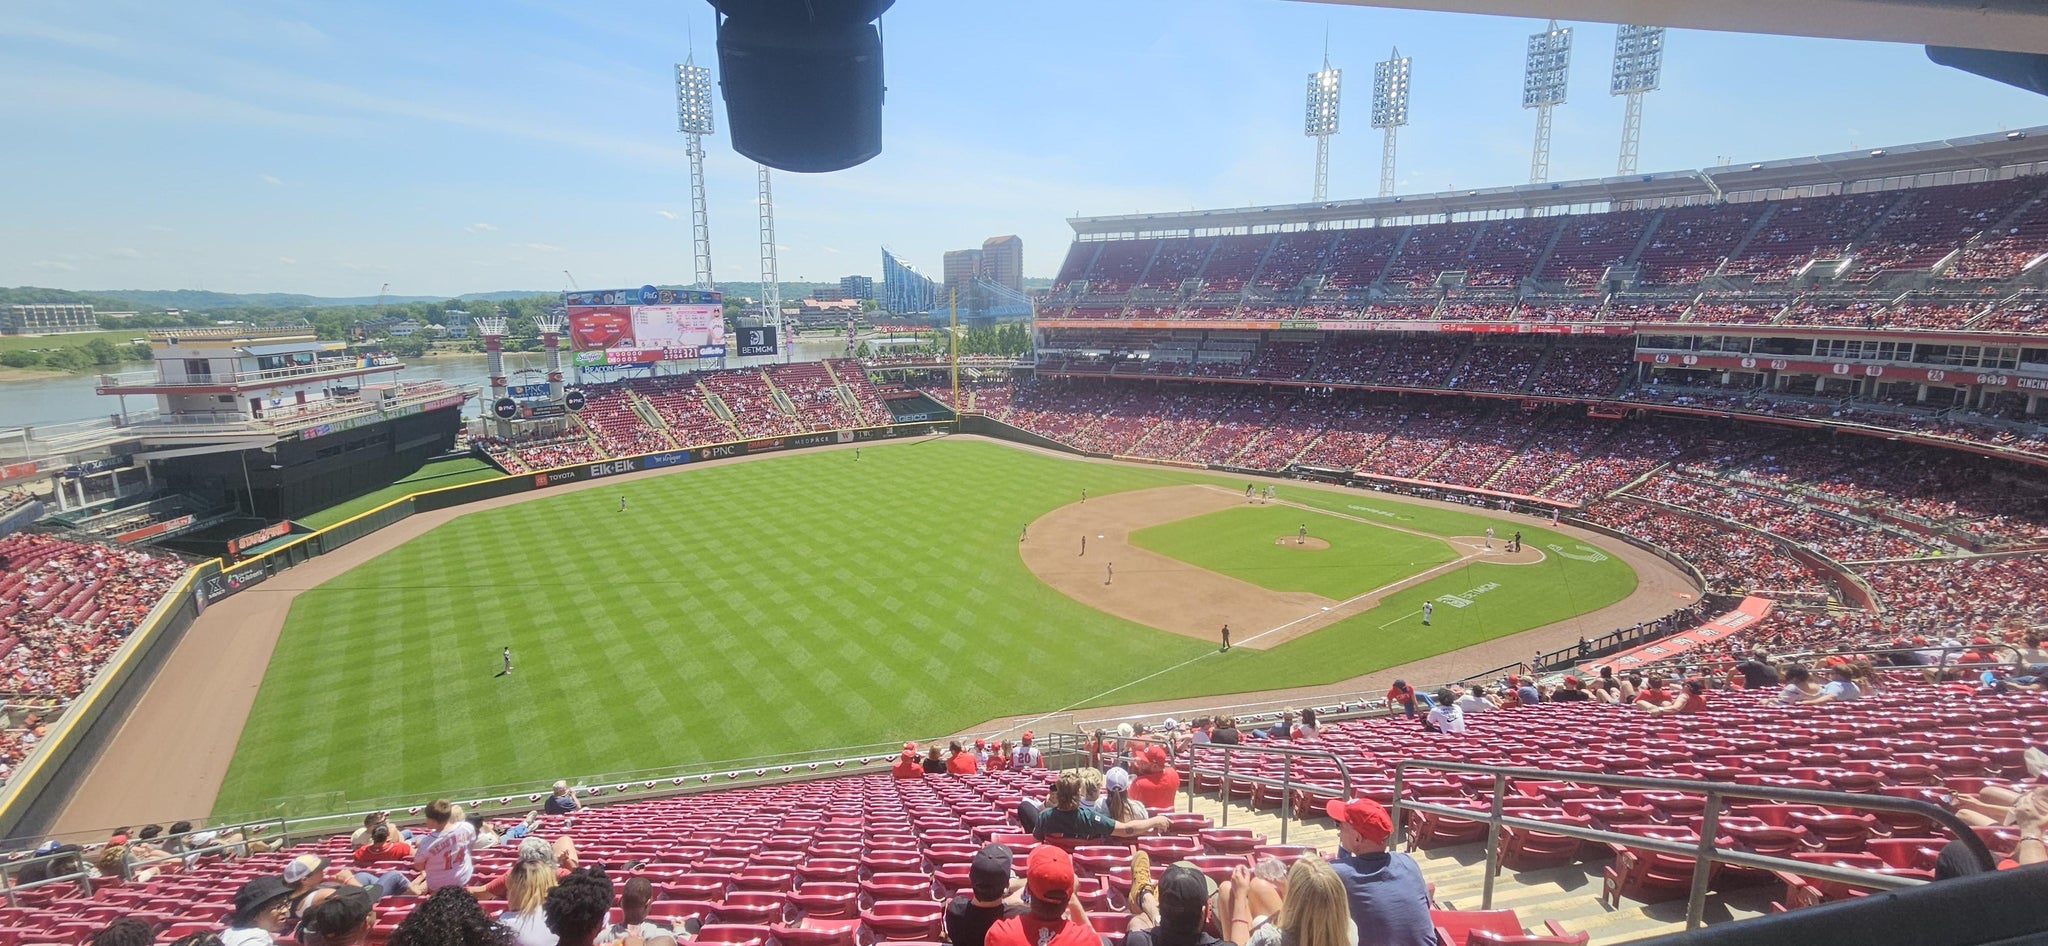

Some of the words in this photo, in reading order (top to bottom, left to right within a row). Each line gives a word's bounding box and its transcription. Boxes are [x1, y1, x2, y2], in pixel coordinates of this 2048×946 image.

[700, 346, 723, 356] Gillette
[742, 345, 773, 354] BETMGM
[1655, 354, 1668, 363] 42
[1773, 360, 1785, 369] 20
[584, 365, 615, 374] BEACON
[524, 385, 544, 393] PNC
[898, 414, 928, 422] GEICO
[329, 422, 345, 433] BUY
[794, 436, 829, 445] MEDPACE
[713, 446, 735, 457] PNC
[549, 472, 575, 481] TOYOTA
[1018, 752, 1031, 764] 20
[443, 844, 465, 870] 14
